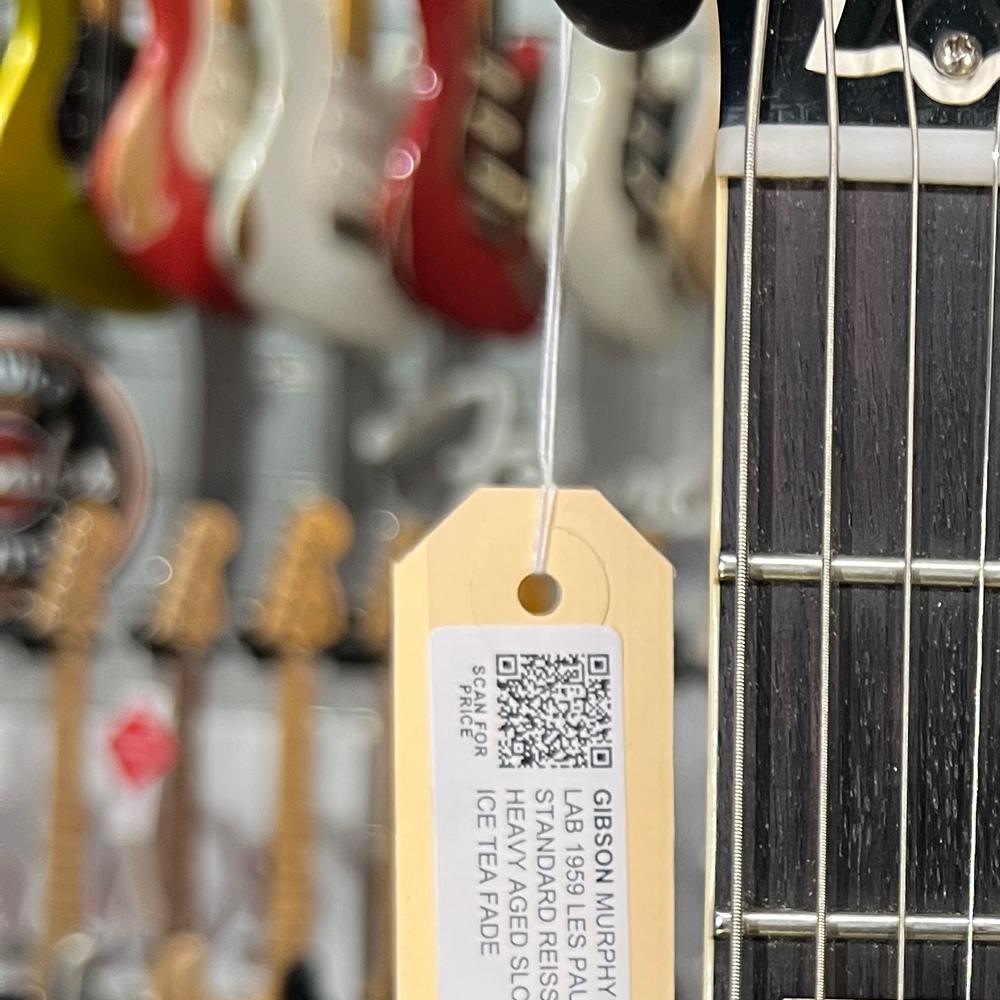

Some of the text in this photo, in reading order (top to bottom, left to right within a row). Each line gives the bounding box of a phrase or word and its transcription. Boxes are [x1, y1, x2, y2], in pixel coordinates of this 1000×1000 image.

[458, 685, 474, 738] PRICE
[472, 664, 488, 757] SCAN FOR
[506, 789, 527, 871] HEAVY
[564, 789, 584, 833] LAB
[476, 789, 499, 955] ICE TEA FADE
[535, 789, 557, 922] STANDARD
[566, 843, 585, 895] 1959
[593, 789, 616, 997] GIBSON MURPHY
[508, 878, 528, 947] AGED
[566, 904, 586, 948] LES
